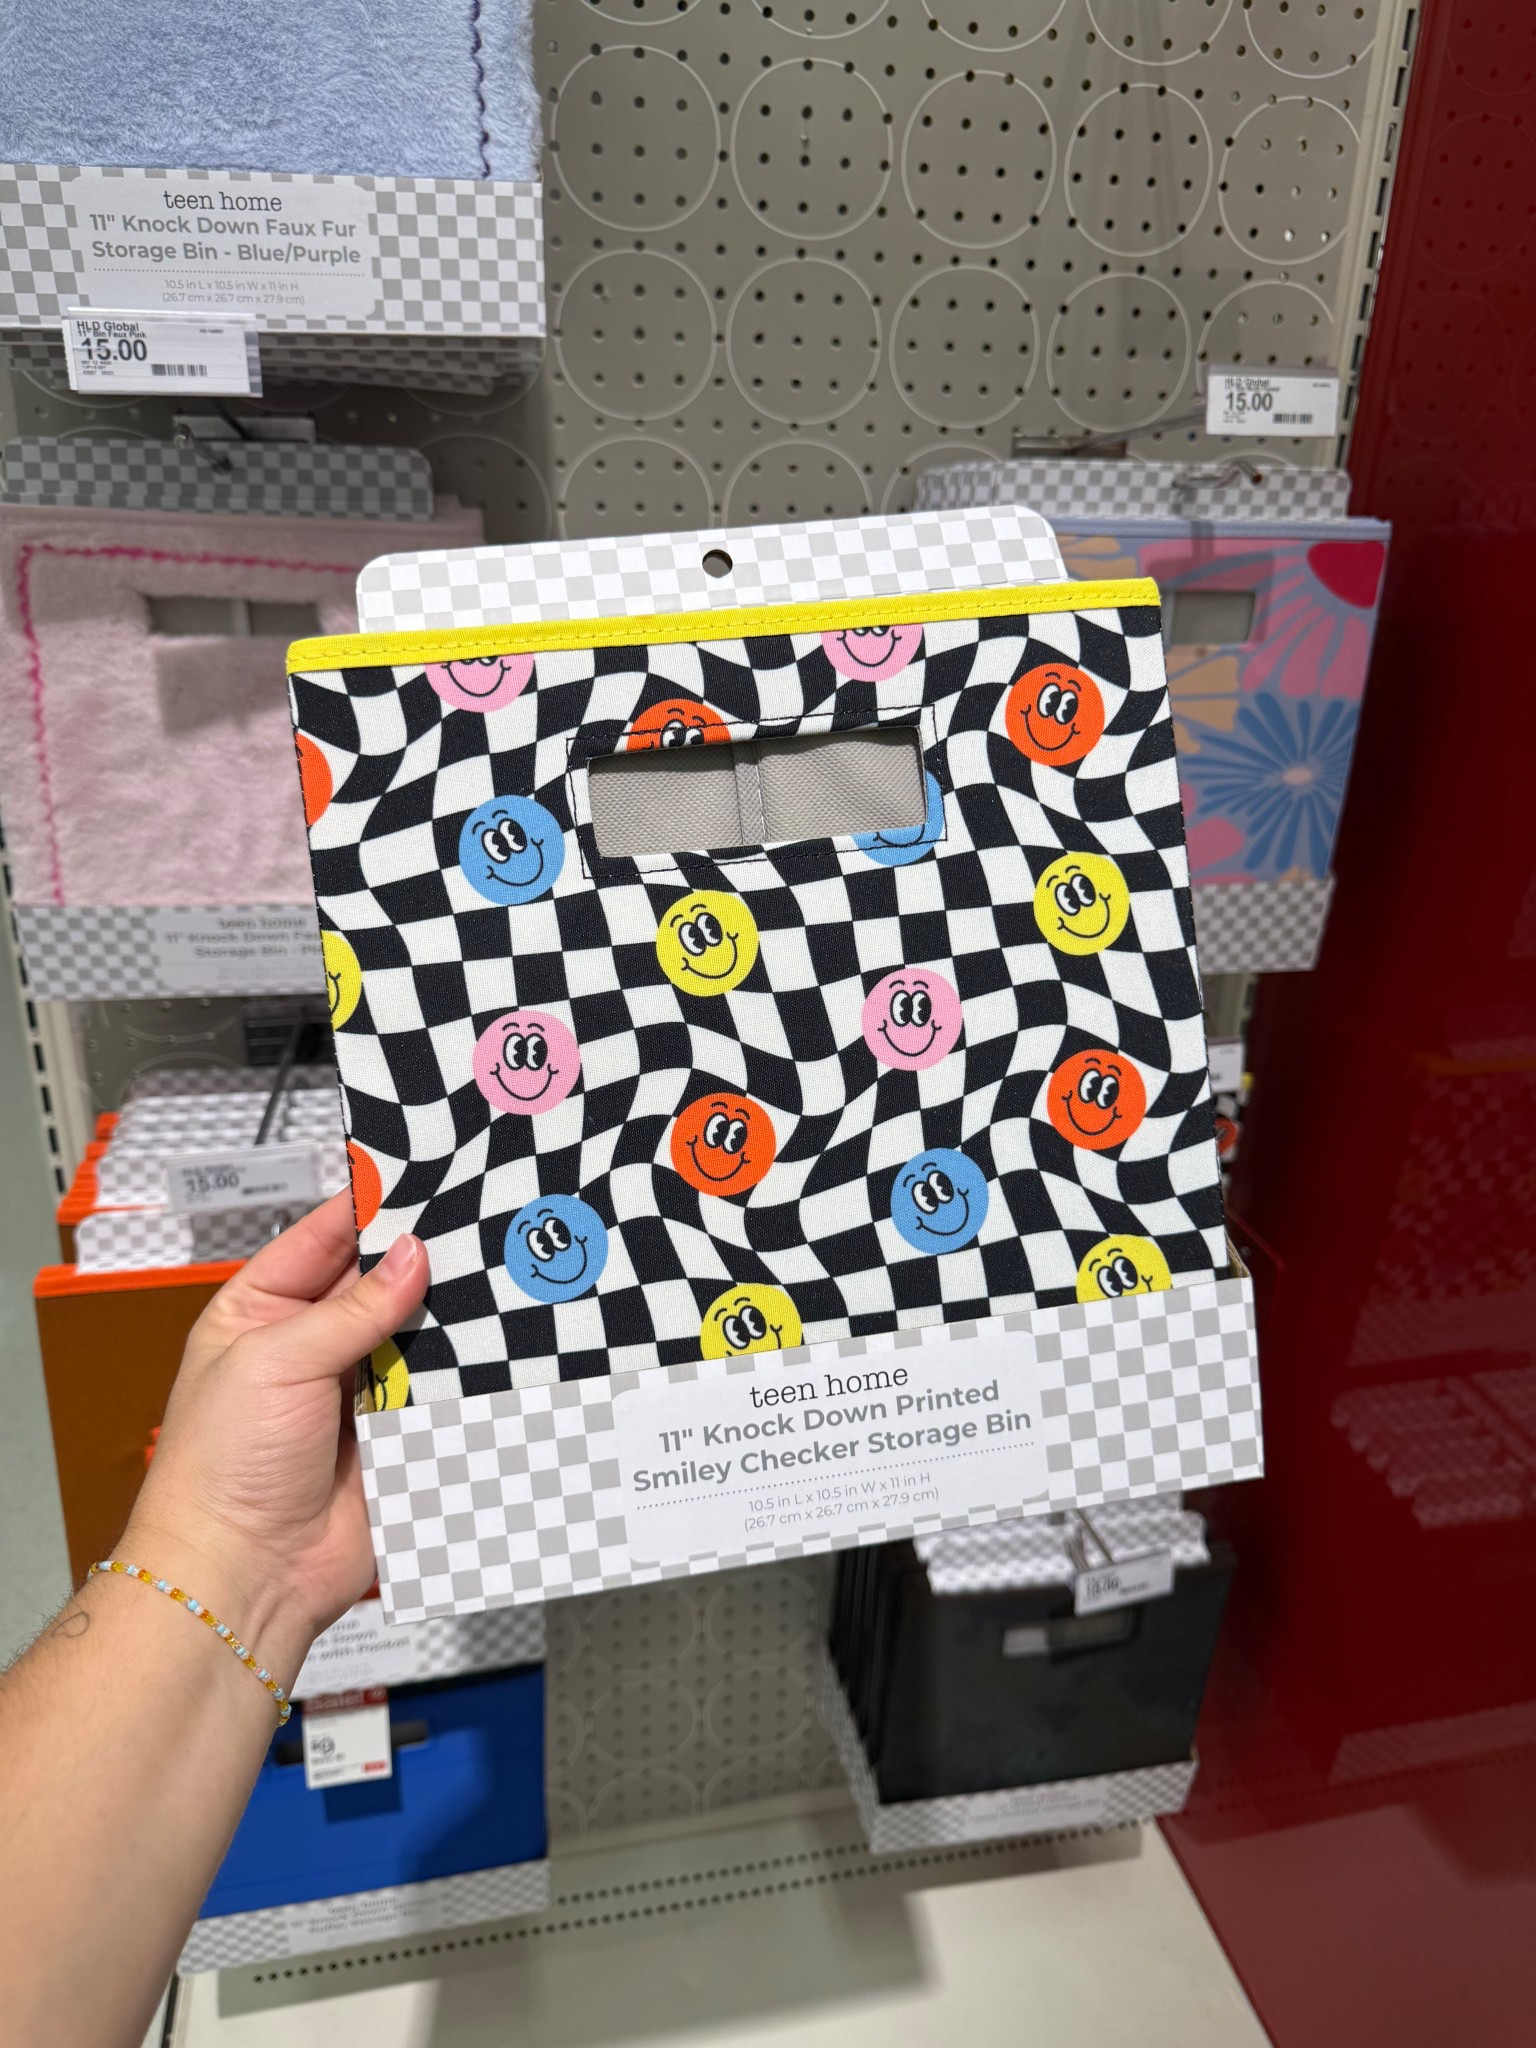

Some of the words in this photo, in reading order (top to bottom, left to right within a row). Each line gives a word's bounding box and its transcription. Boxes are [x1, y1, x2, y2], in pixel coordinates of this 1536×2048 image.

[163, 190, 215, 209] teen
[219, 191, 282, 212] home
[89, 214, 115, 231] 11"
[122, 215, 191, 233] Knock
[197, 217, 259, 235] Down
[266, 219, 316, 236] Faux
[322, 220, 356, 237] Fur
[92, 240, 177, 263] Storage
[183, 242, 218, 260] Bin
[238, 243, 361, 267] Blue/Purple
[164, 280, 184, 290] 10.5
[187, 280, 197, 290] in
[200, 280, 207, 290] L
[236, 280, 246, 291] in
[247, 281, 259, 291] W
[280, 281, 288, 291] in
[291, 282, 299, 292] H
[237, 295, 254, 303] cm
[77, 321, 100, 331] HLD
[104, 321, 139, 332] Global
[81, 338, 147, 361] 15.00
[1226, 392, 1273, 412] 15.00
[749, 1381, 818, 1408] teen
[824, 1367, 908, 1397] home
[659, 1428, 693, 1453] 11"
[703, 1413, 796, 1446] Knock
[804, 1401, 887, 1430] Down
[896, 1379, 999, 1415] Printed
[633, 1459, 732, 1491] Smiley
[740, 1439, 859, 1474] Checker
[868, 1421, 977, 1453] Storage
[986, 1408, 1031, 1434] Bin
[748, 1497, 775, 1512] 10.5
[778, 1495, 790, 1508] in
[795, 1493, 803, 1505] L
[806, 1493, 814, 1503] x
[816, 1486, 841, 1501] 10.5
[845, 1484, 857, 1496] in
[861, 1481, 876, 1493] W
[880, 1481, 887, 1491] x
[890, 1476, 900, 1489] 11
[903, 1475, 916, 1487] in
[920, 1471, 931, 1484] H
[744, 1514, 776, 1532] (26.7
[779, 1512, 802, 1524] cm
[805, 1510, 813, 1520] x
[815, 1503, 843, 1518] 26.7
[846, 1501, 869, 1513] cm
[872, 1499, 880, 1509] x
[882, 1491, 910, 1507] 27.9
[912, 1487, 939, 1502] cm)
